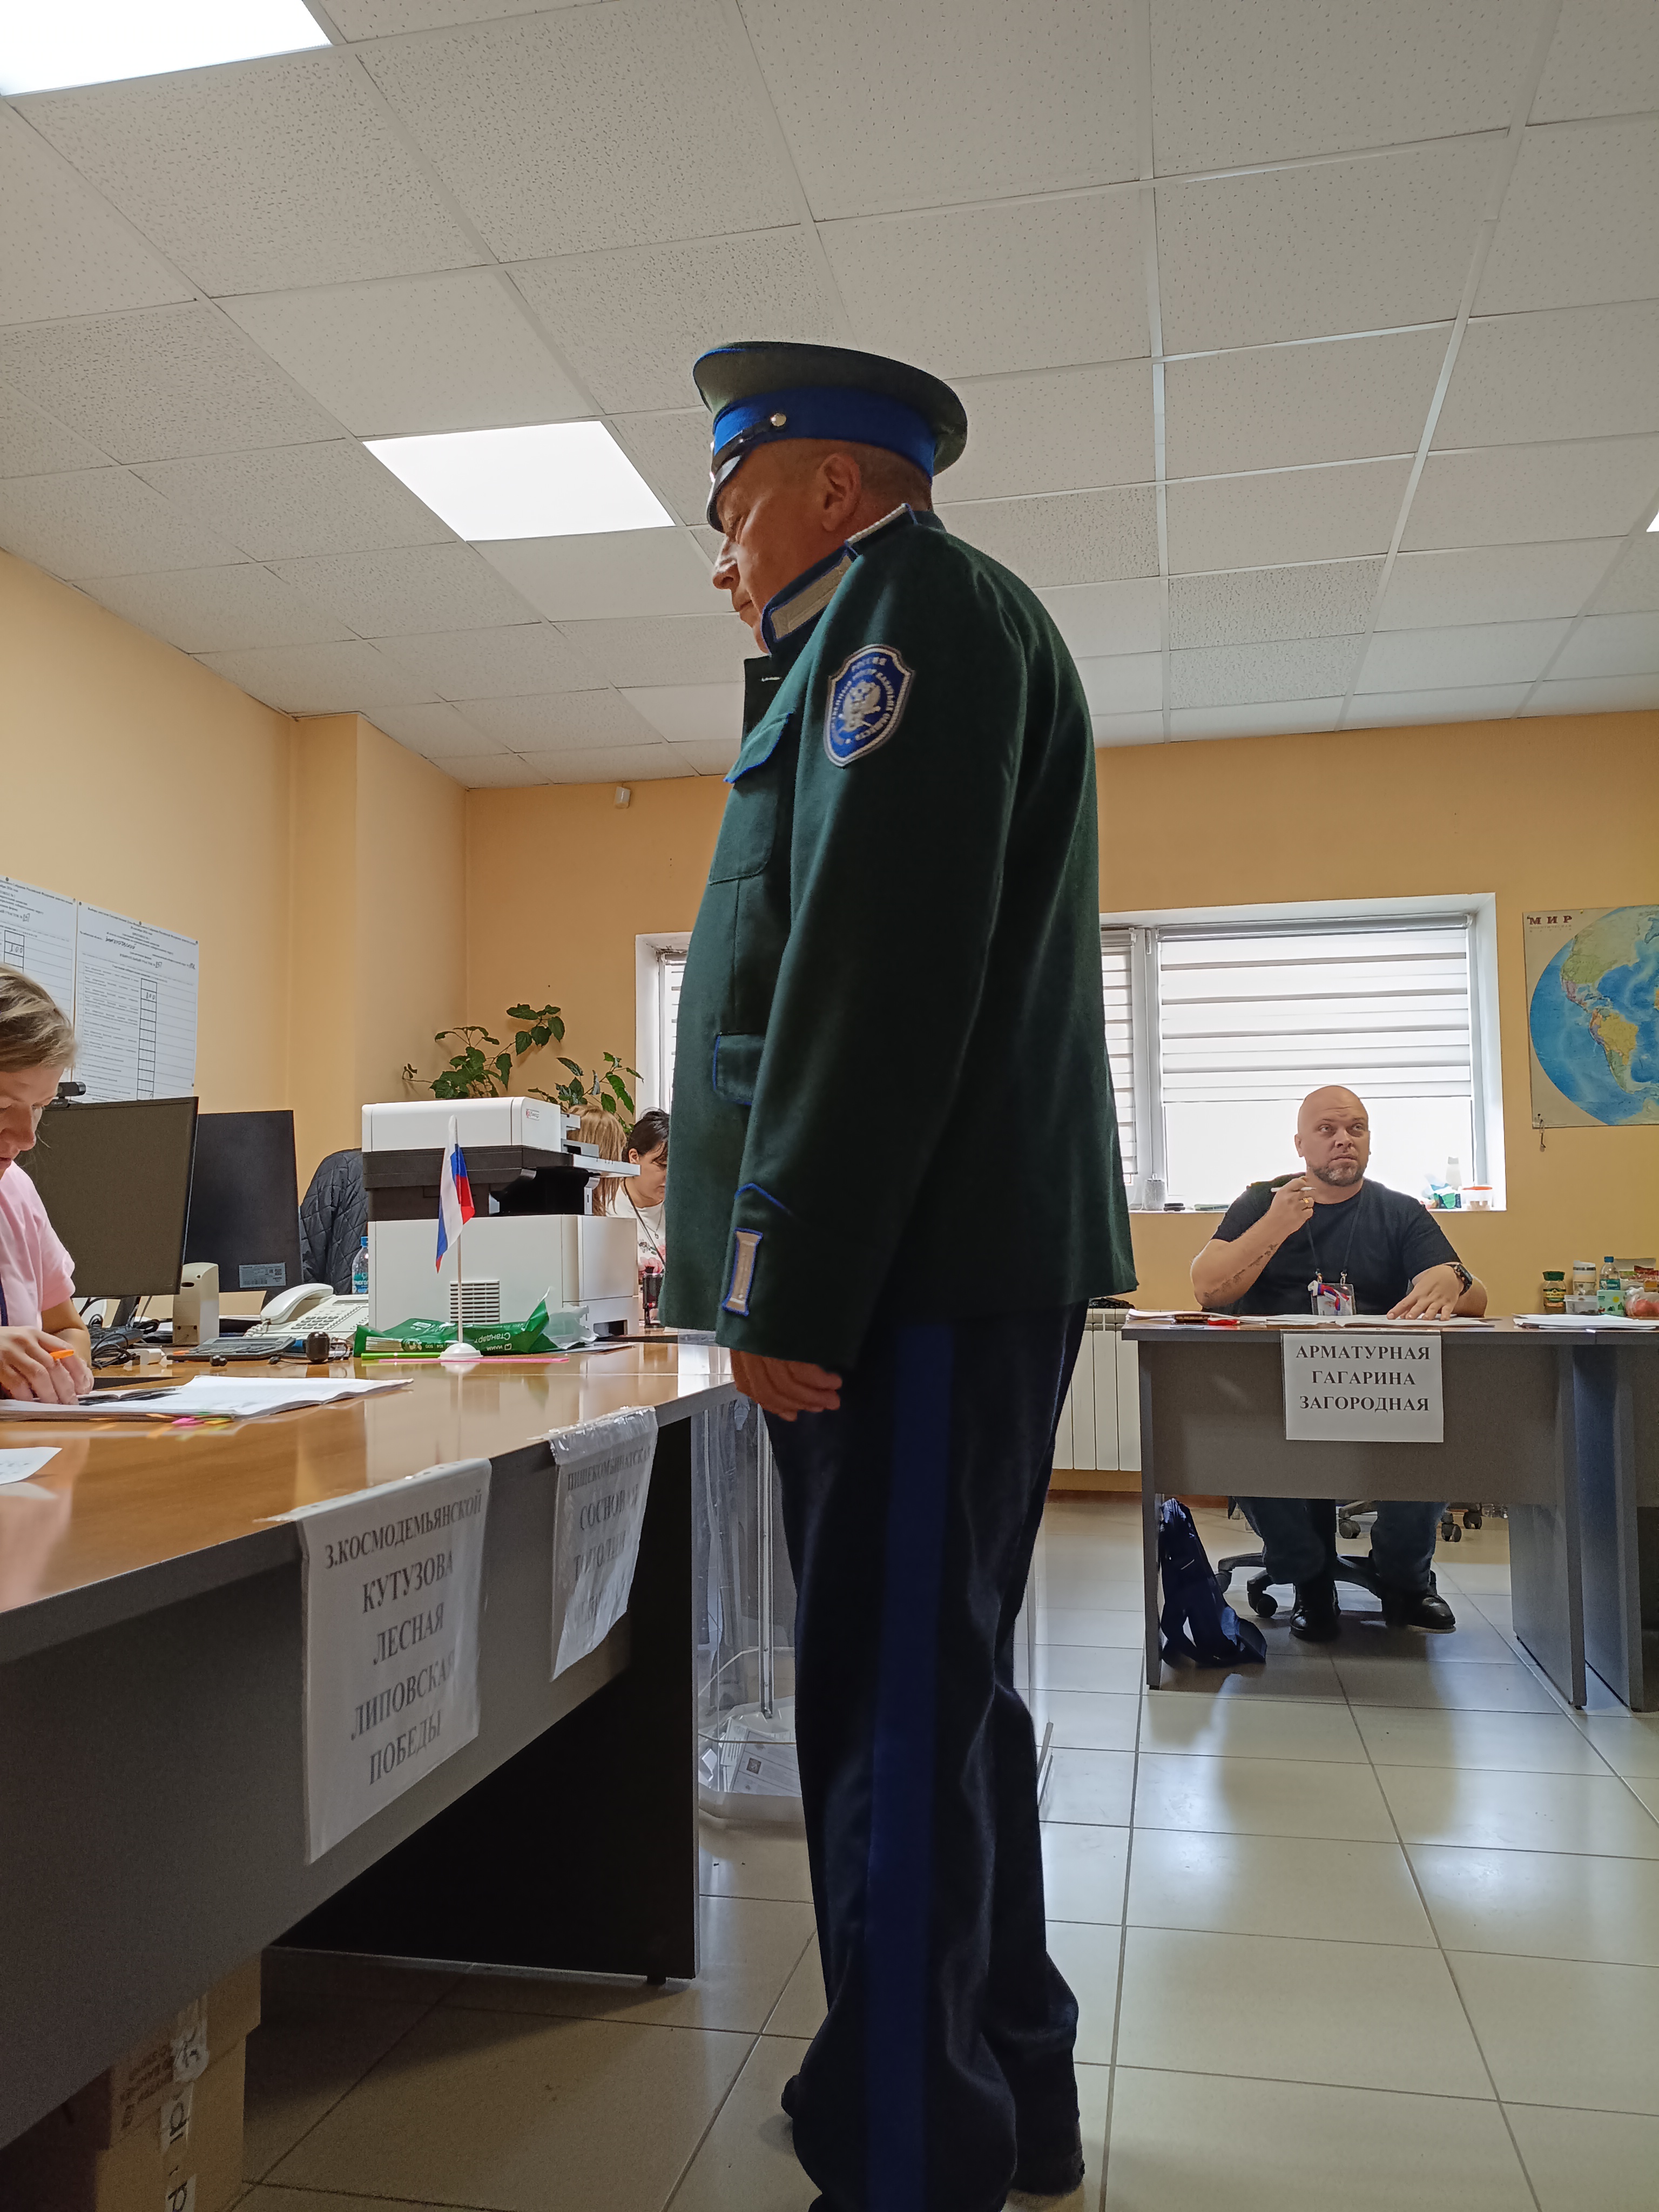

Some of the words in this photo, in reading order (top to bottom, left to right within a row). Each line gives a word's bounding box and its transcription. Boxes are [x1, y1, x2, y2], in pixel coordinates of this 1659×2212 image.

[1529, 915, 1573, 925] МИР
[474, 1332, 511, 1344] Стандарт
[1296, 1345, 1431, 1360] АРМАТУРНАЯ
[1312, 1371, 1416, 1385] ГАГАРИНА
[1299, 1395, 1430, 1413] ЗАГОРОДНАЯ
[325, 1488, 482, 1569] З.КОСМОДЕМЬЯНСКОЙ
[362, 1549, 453, 1614] КУТУЗОВА
[373, 1602, 444, 1665] ЛЕСНАЯ
[369, 1709, 441, 1785] ПОБЕДЫ
